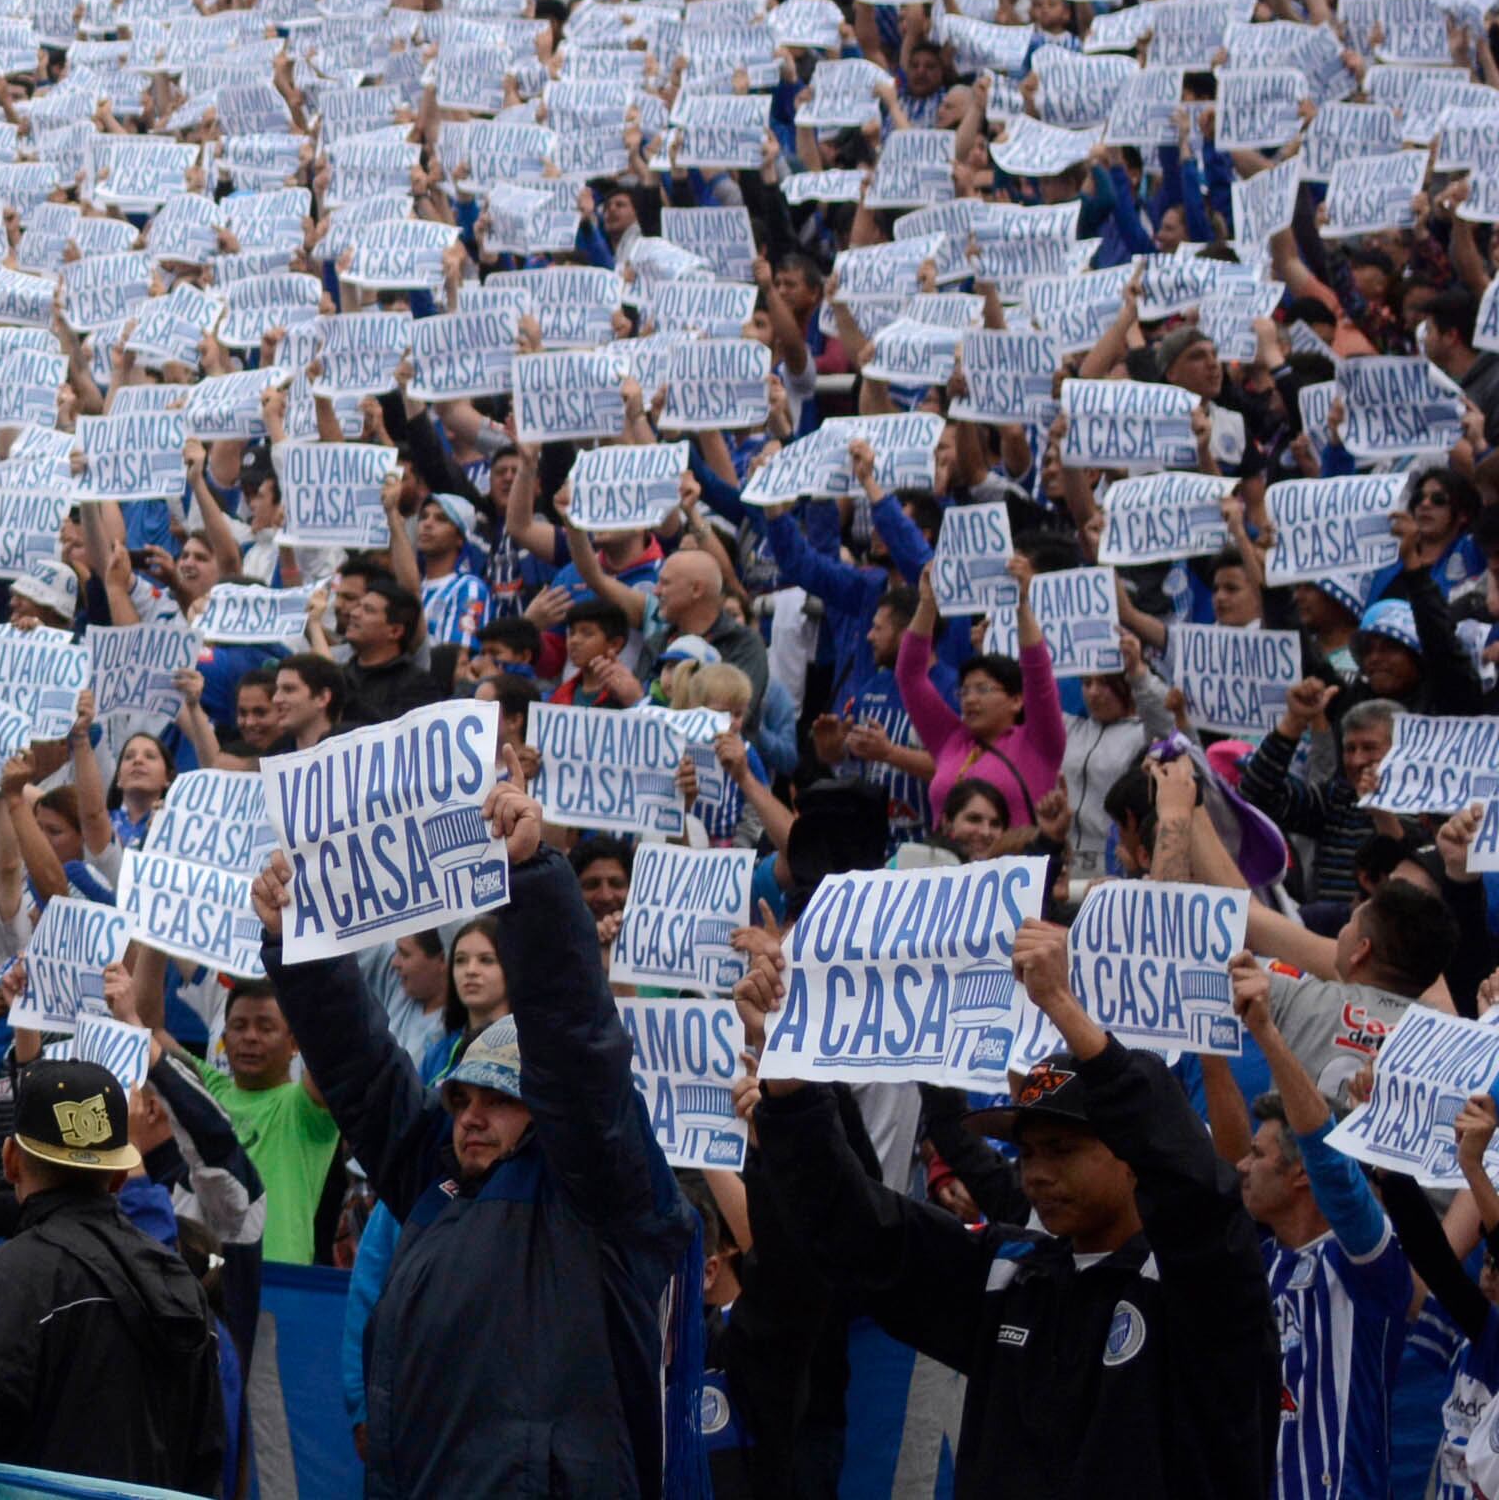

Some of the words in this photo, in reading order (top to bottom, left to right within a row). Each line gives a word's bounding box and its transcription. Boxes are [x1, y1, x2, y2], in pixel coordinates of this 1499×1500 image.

[665, 210, 749, 241] VOLVAMOS
[1342, 195, 1386, 221] CASA
[65, 257, 152, 292] VOLVAMOS
[348, 254, 361, 276] A
[366, 250, 417, 278] CASA
[853, 258, 895, 288] CASA
[658, 285, 751, 318] VOLVAMOS
[1158, 267, 1217, 300] CASA
[79, 290, 127, 326] CASA
[224, 315, 237, 338] A
[544, 307, 588, 339] CASA
[323, 317, 410, 350] VOLVAMOS
[412, 318, 513, 356] VOLVAMOS
[322, 362, 332, 385] A
[335, 355, 381, 385] CASA
[413, 363, 427, 389] A
[430, 354, 486, 387] CASA
[885, 337, 931, 369] CASA
[518, 357, 624, 391] VOLVAMOS
[523, 398, 537, 430] A
[539, 392, 596, 428] CASA
[666, 386, 679, 416] A
[684, 384, 737, 417] CASA
[1067, 382, 1191, 418] VOLVAMOS
[82, 418, 184, 454] VOLVAMOS
[1066, 420, 1082, 457] A
[1087, 418, 1155, 455] CASA
[1365, 405, 1430, 443] CASA
[78, 463, 93, 490] A
[97, 453, 153, 492] CASA
[301, 488, 356, 525] CASA
[572, 490, 582, 520] A
[589, 484, 648, 520] CASA
[1111, 475, 1225, 512] VOLVAMOS
[1271, 478, 1393, 526] VOLVAMOS
[1107, 516, 1122, 553] A
[1126, 507, 1191, 551] CASA
[1272, 530, 1288, 572] A
[1292, 519, 1359, 566] CASA
[199, 597, 216, 628] A
[219, 595, 278, 630] CASA
[92, 629, 196, 670] VOLVAMOS
[1180, 629, 1294, 681] VOLVAMOS
[102, 668, 149, 710] CASA
[1204, 676, 1260, 727] CASA
[535, 711, 678, 770] VOLVAMOS
[278, 714, 483, 849] VOLVAMOS
[527, 760, 548, 806] A
[555, 765, 635, 816] CASA
[1369, 763, 1391, 805] A
[1394, 763, 1471, 808] CASA
[153, 810, 176, 851] A
[179, 814, 253, 869] CASA
[294, 853, 325, 937] A
[319, 817, 438, 927] CASA
[634, 849, 745, 913] VOLVAMOS
[148, 891, 234, 956] CASA
[791, 866, 1030, 962] VOLVAMOS
[1071, 889, 1239, 962] VOLVAMOS
[615, 908, 631, 965] A
[632, 909, 696, 971] CASA
[37, 960, 84, 1015] CASA
[1070, 955, 1088, 1015] A
[1096, 956, 1184, 1028] CASA
[767, 967, 808, 1052] A
[819, 964, 950, 1057] CASA
[1379, 1014, 1499, 1090] VOLVAMOS
[1348, 1074, 1380, 1138] A
[1373, 1076, 1439, 1154] CASA
